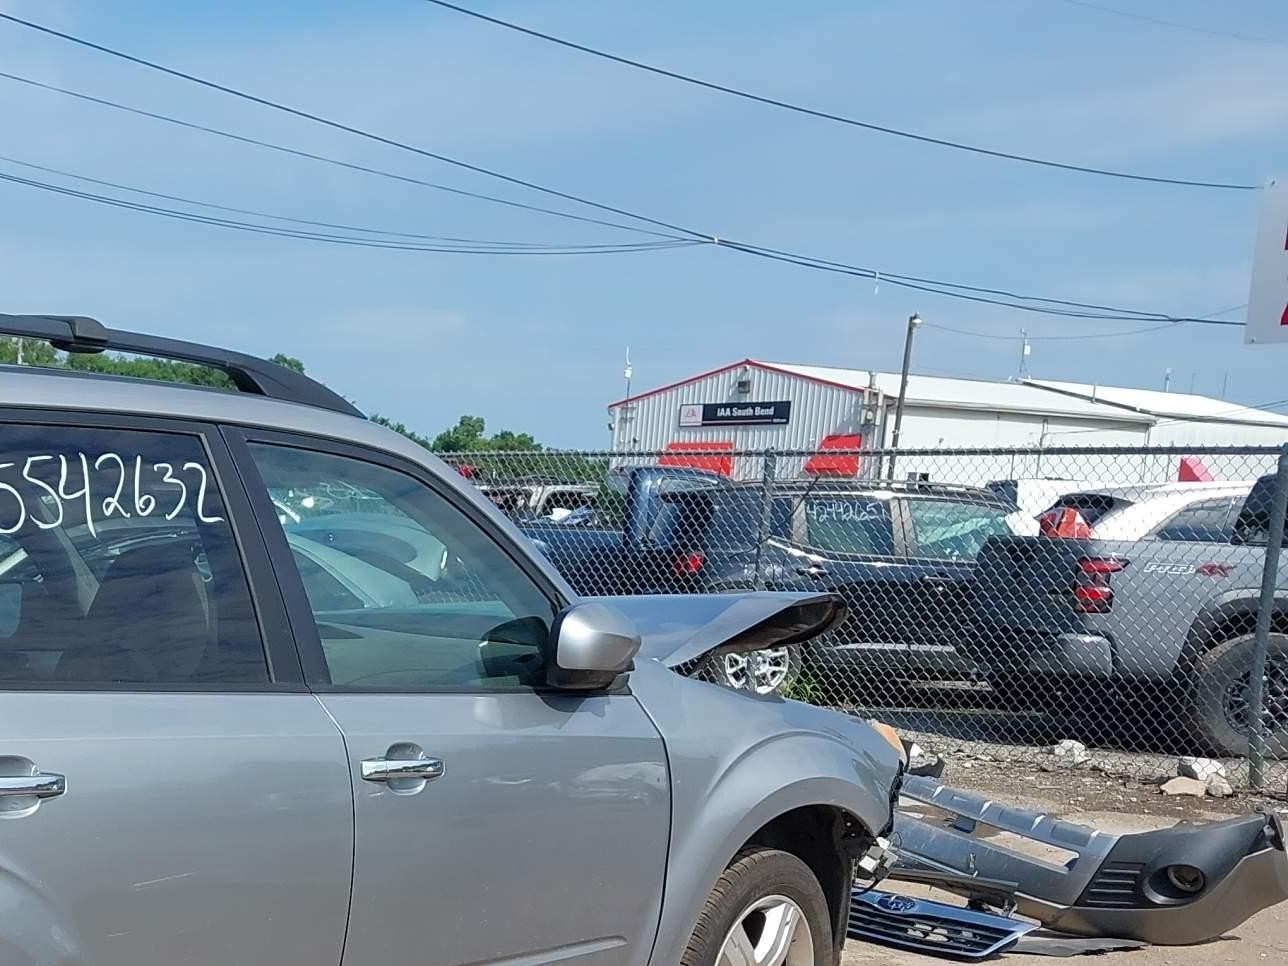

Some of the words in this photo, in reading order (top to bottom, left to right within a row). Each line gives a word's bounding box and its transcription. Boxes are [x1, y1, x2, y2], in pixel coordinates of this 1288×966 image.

[717, 407, 731, 417] IAA
[732, 406, 753, 416] South
[754, 405, 775, 416] Bend
